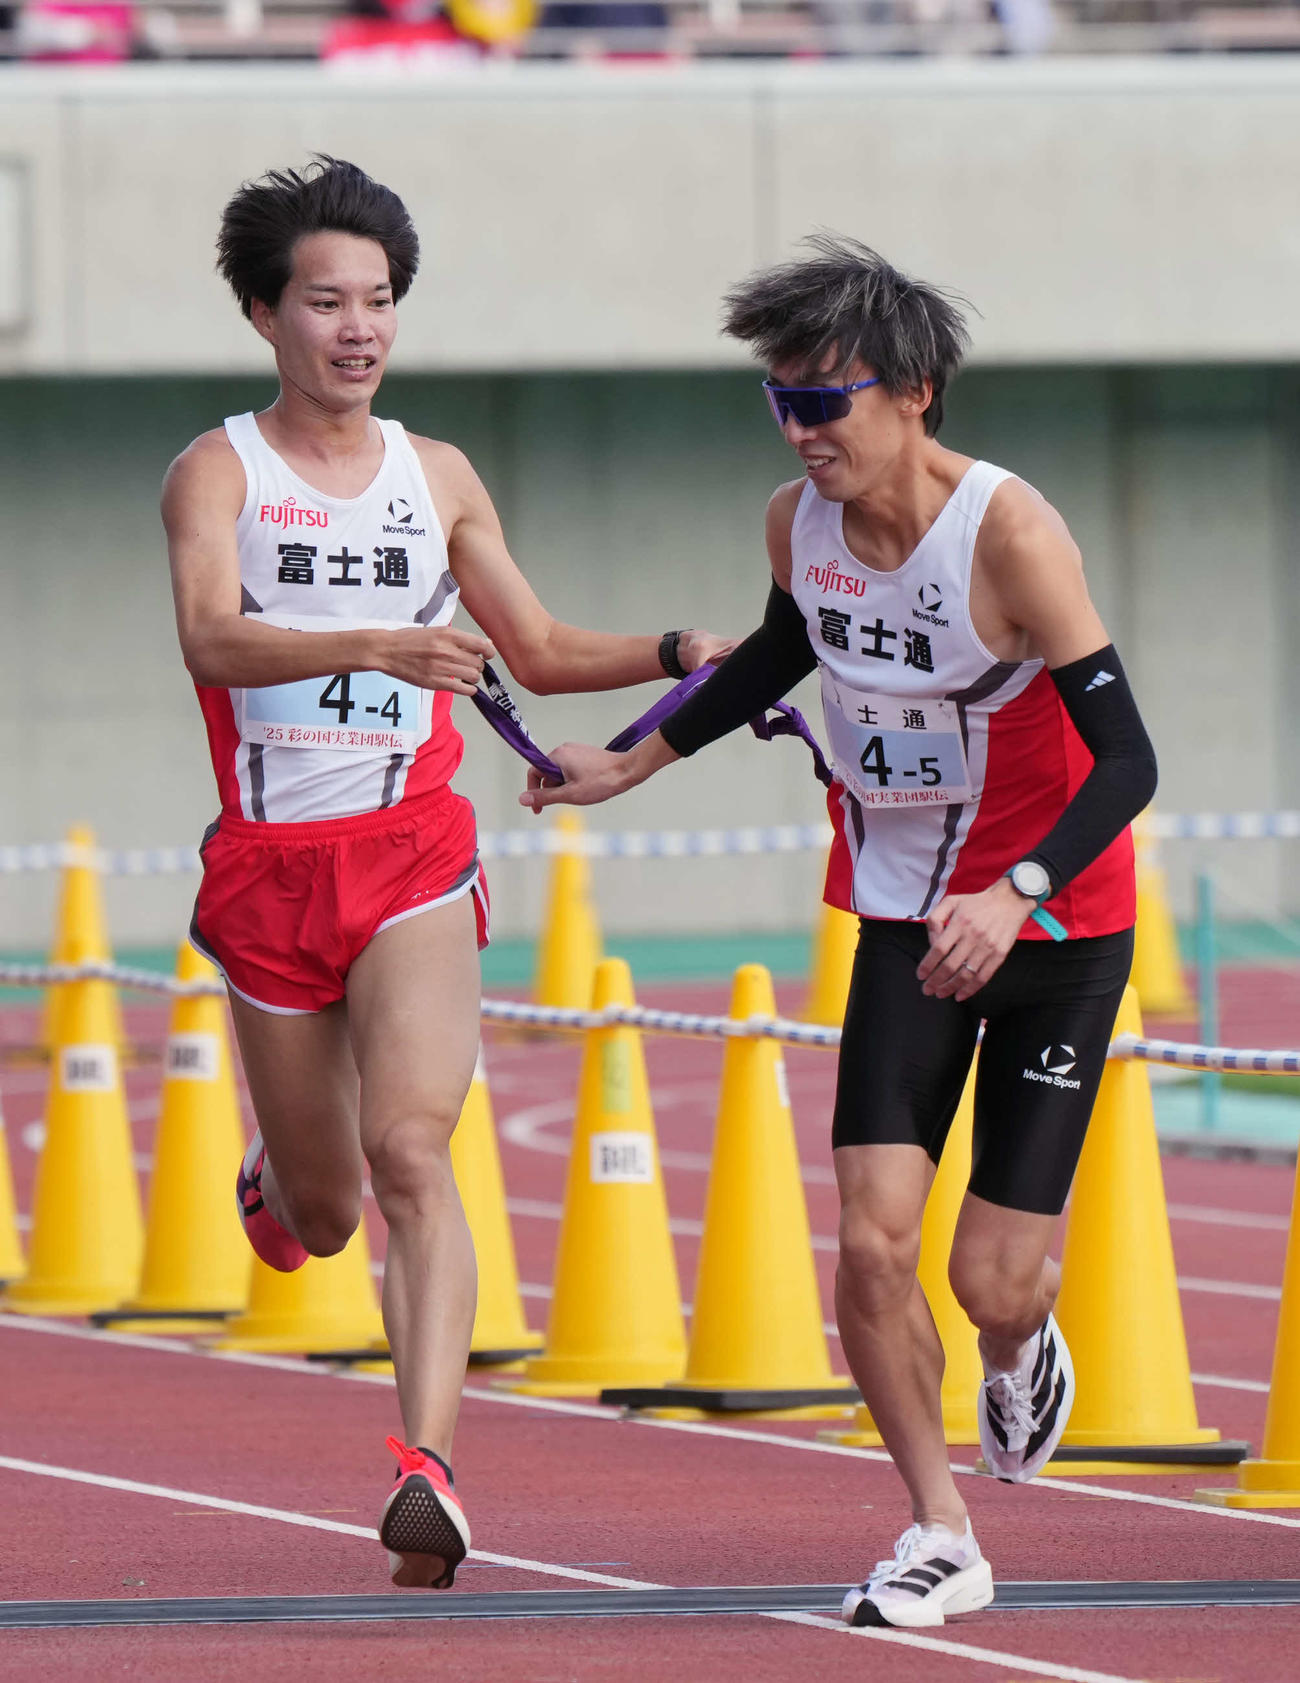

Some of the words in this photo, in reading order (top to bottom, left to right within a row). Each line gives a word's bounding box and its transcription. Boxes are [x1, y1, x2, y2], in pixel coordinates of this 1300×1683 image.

[260, 497, 328, 530] FUJITSU
[278, 543, 410, 587] 富士通
[805, 560, 866, 597] FUJITSU
[818, 606, 935, 674] 富士通
